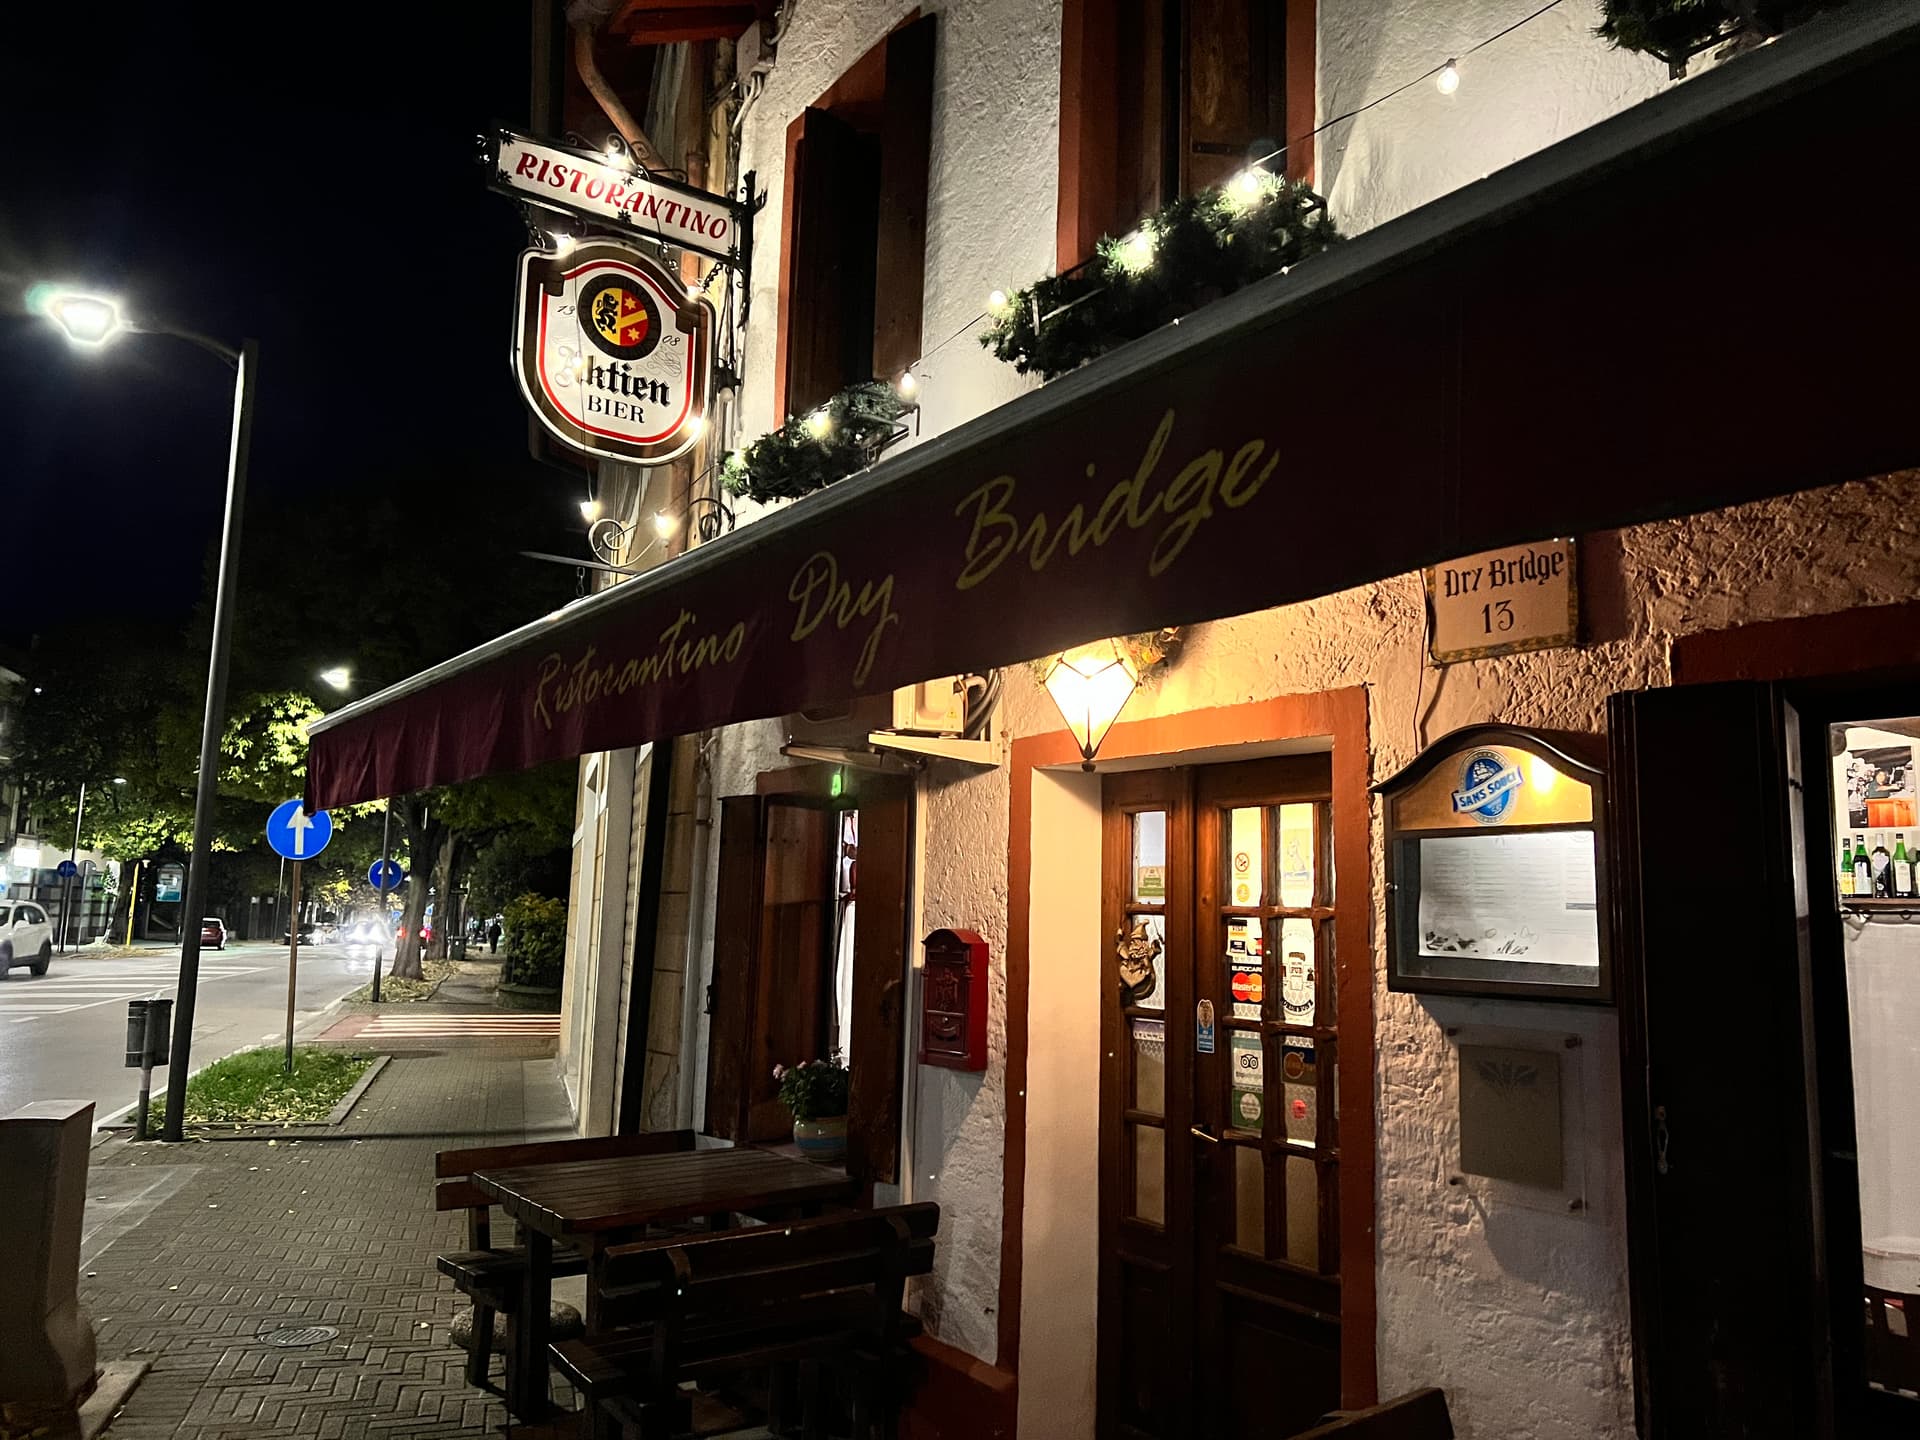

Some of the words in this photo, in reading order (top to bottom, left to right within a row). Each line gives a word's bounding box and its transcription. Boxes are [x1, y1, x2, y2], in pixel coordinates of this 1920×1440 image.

[515, 151, 728, 240] RISTORANTINO
[556, 303, 576, 316] 13
[662, 334, 681, 347] 08
[560, 346, 671, 407] ktien
[587, 394, 646, 424] BIER
[533, 608, 745, 730] Ristorantino
[788, 551, 899, 689] Dry
[954, 408, 1281, 590] Bridge
[1444, 567, 1483, 599] Dry
[1488, 547, 1566, 587] Bridge
[1481, 599, 1516, 635] 13
[1459, 788, 1487, 808] SANS
